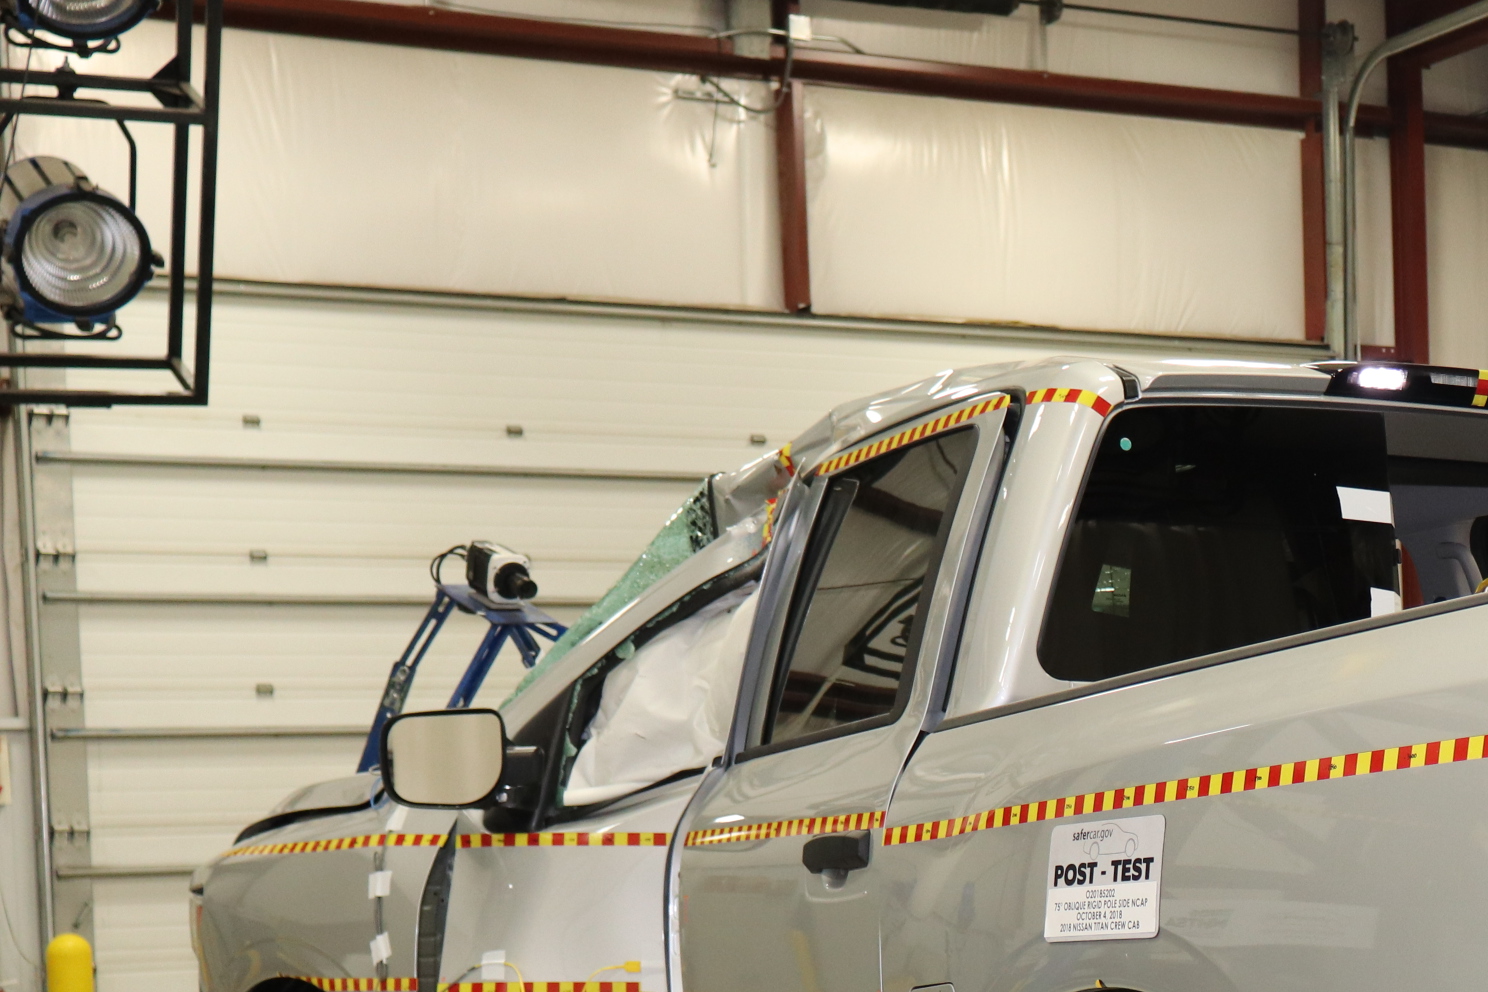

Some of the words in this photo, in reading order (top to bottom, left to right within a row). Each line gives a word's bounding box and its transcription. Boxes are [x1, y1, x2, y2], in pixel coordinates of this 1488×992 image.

[1072, 828, 1114, 842] safercar.gov
[1053, 861, 1098, 887] POST
[1111, 856, 1155, 883] TEST
[1063, 901, 1086, 911] OBLIQUE
[1087, 900, 1102, 910] RIGID
[1103, 899, 1117, 909] POLE
[1118, 898, 1130, 908] SIDE
[1131, 897, 1148, 907] NCAP
[1076, 911, 1102, 921] OCTOBER
[1109, 910, 1123, 920] 2018
[1060, 923, 1071, 933] 2018
[1072, 922, 1092, 932] NISSAN
[1093, 921, 1109, 931] TITAN
[1109, 921, 1126, 931] CREW
[1127, 920, 1140, 930] CAB
